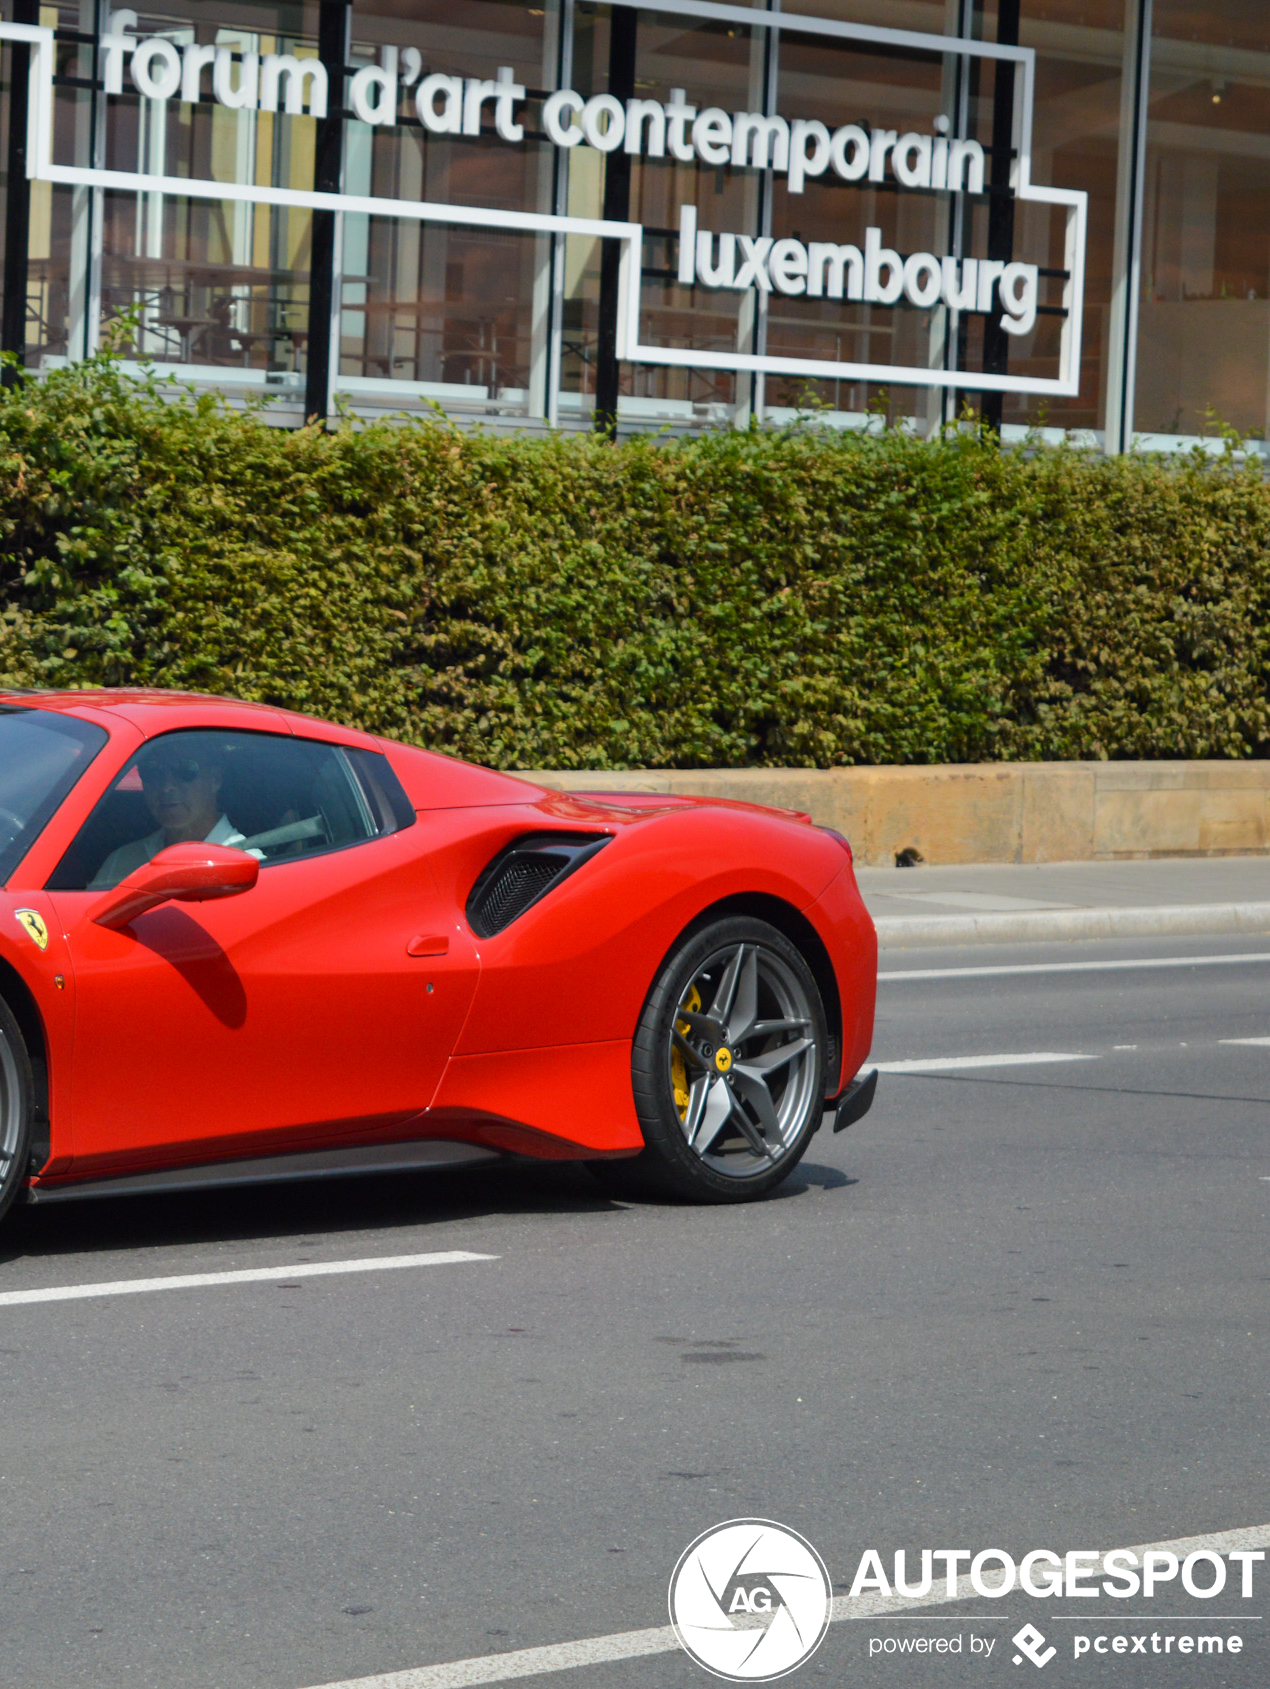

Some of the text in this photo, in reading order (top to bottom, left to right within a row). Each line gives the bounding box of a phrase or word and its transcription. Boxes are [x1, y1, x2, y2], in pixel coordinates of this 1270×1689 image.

[101, 8, 985, 195] forum d'art contemporain
[678, 204, 1039, 336] luxembourg
